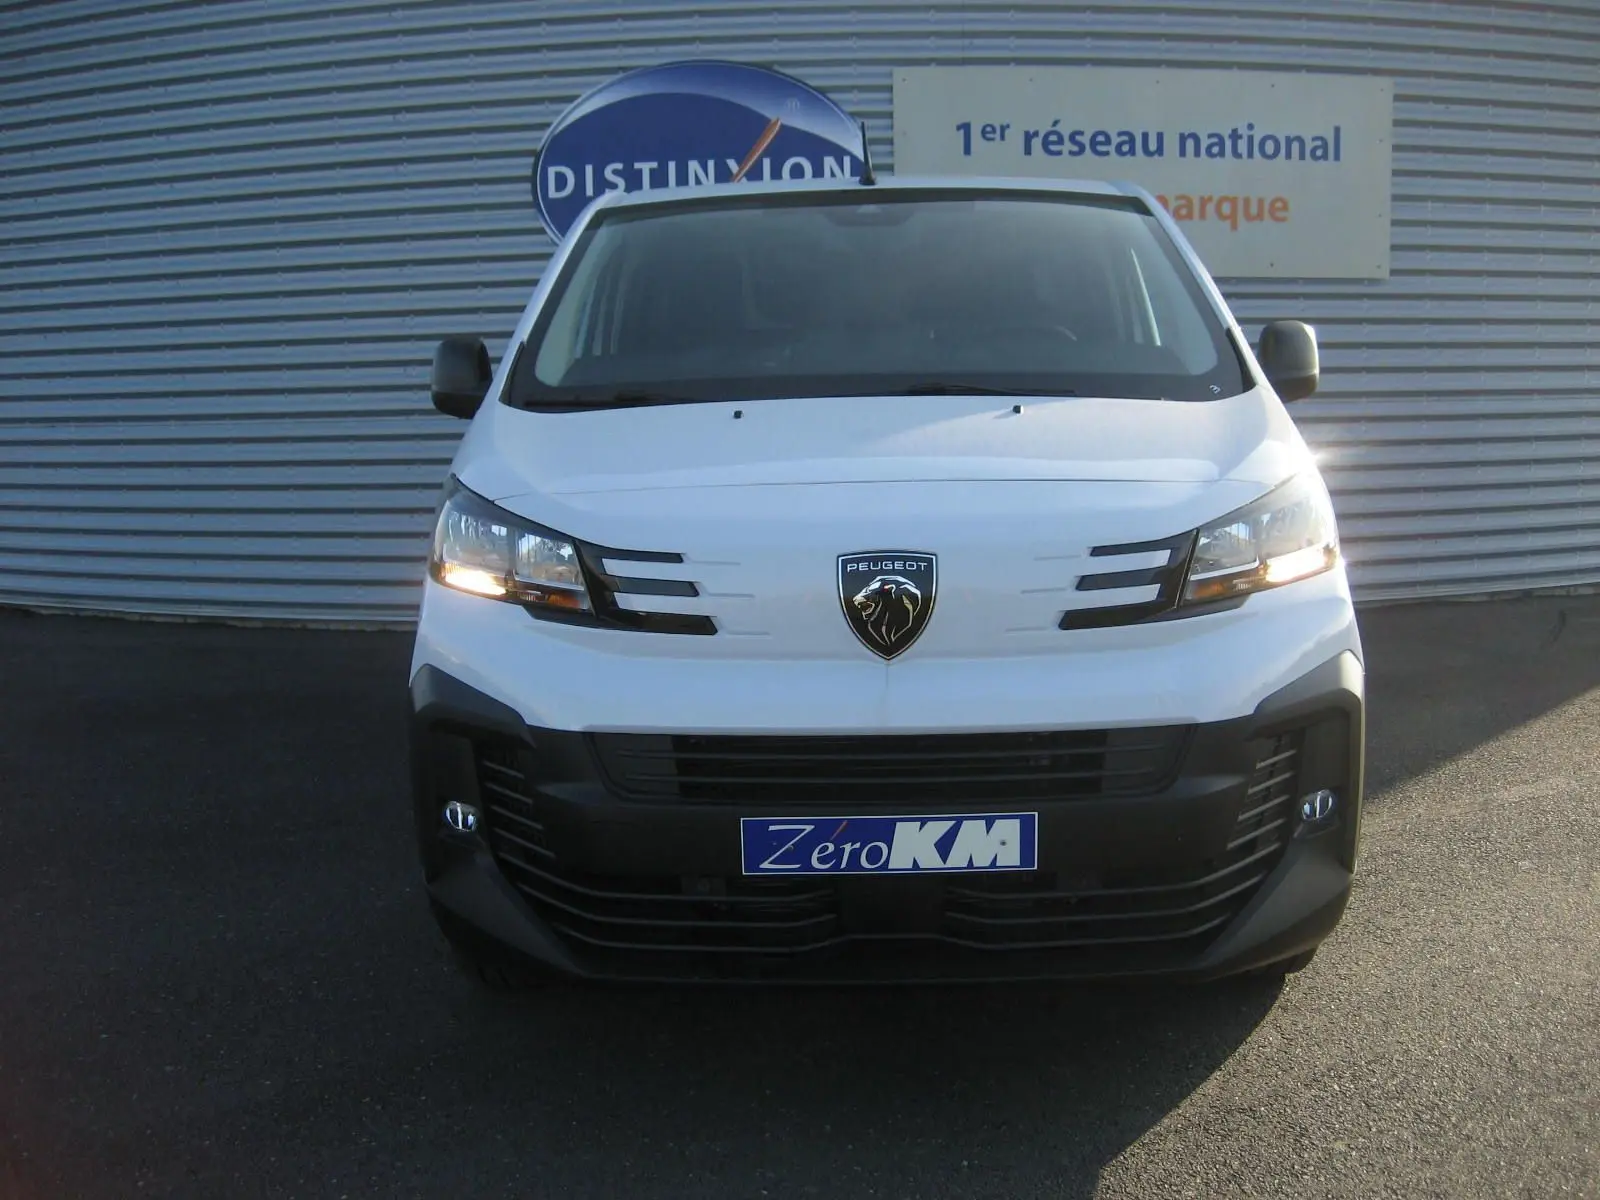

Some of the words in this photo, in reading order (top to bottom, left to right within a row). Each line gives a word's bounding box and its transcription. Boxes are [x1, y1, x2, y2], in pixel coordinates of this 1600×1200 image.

[1023, 119, 1165, 157] réseau
[1178, 122, 1341, 162] national
[547, 155, 851, 198] DISTINXION
[847, 561, 927, 572] PEUGEOT
